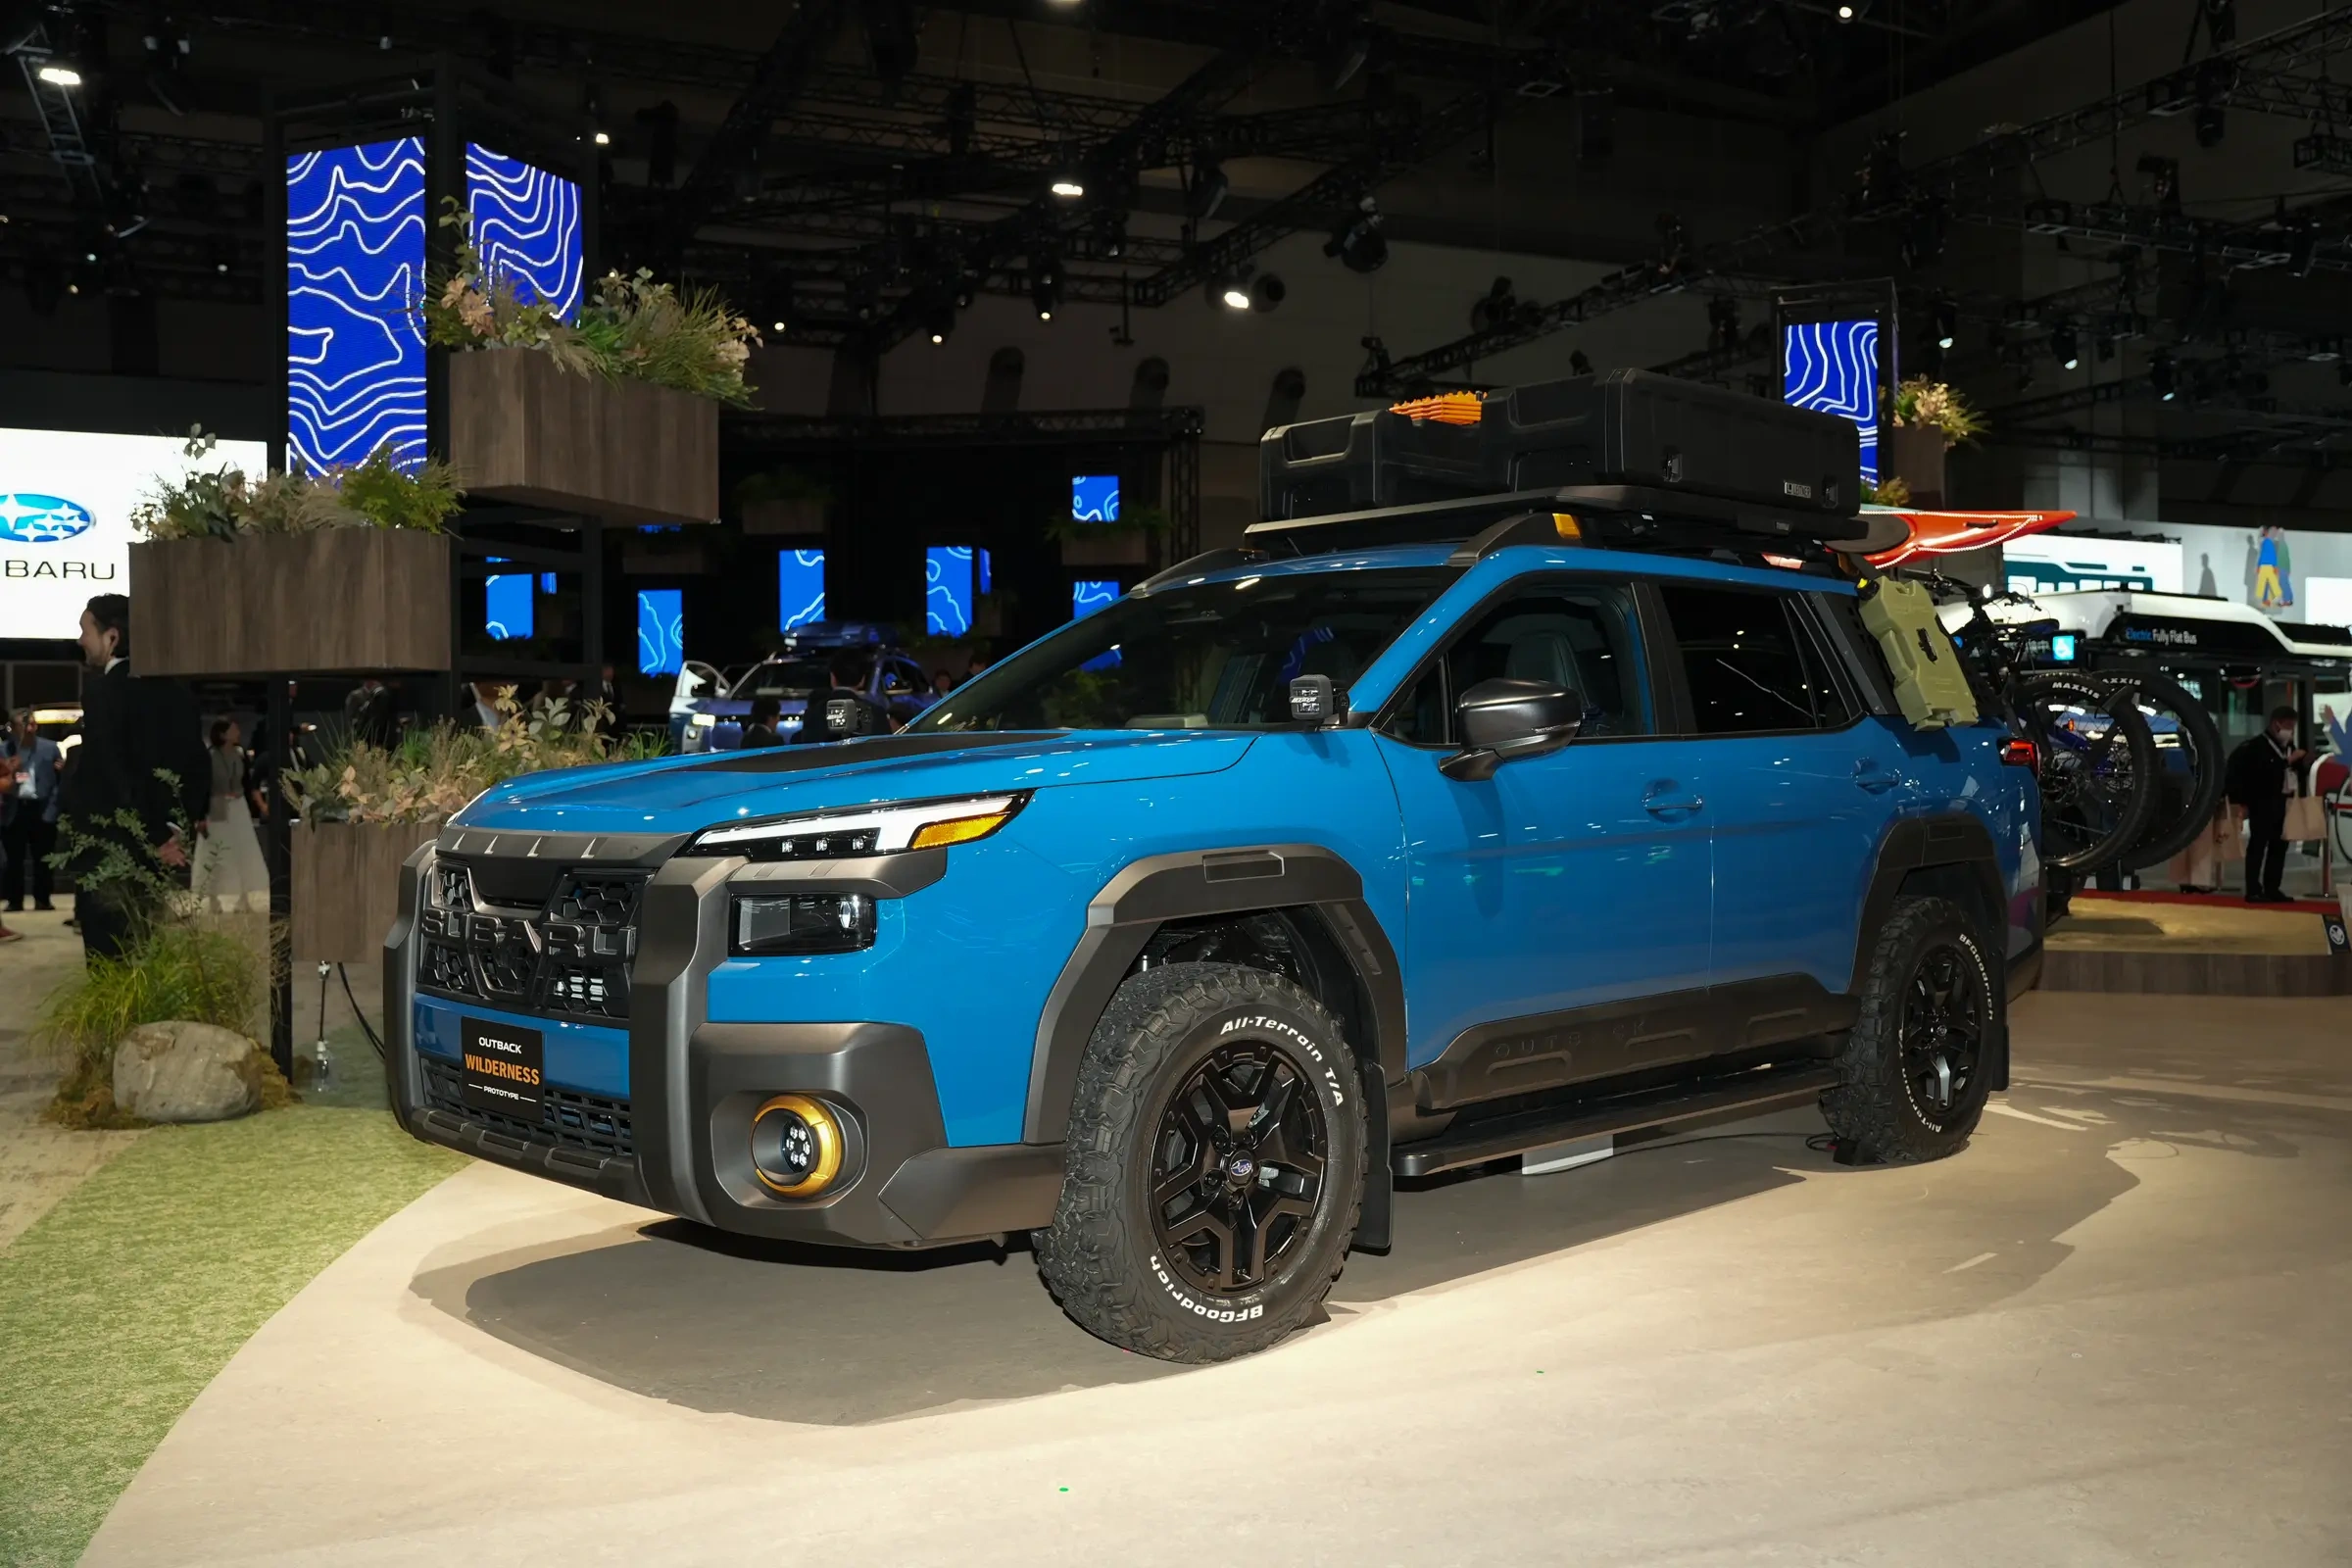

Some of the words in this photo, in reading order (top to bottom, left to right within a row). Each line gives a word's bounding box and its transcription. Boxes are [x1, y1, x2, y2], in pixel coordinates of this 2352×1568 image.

[2126, 627, 2152, 640] Electric
[2153, 629, 2169, 646] Fully
[2170, 630, 2183, 645] Flat
[2183, 631, 2197, 645] Bus
[2052, 681, 2100, 700] MAXXIS
[2102, 677, 2142, 686] AXXIS
[420, 908, 637, 962] SUBARU
[1959, 933, 1994, 1020] BFGoodrich
[478, 1036, 522, 1055] OUTBACK
[1494, 1018, 1646, 1058] OUTBCK
[465, 1054, 540, 1087] WILDERNESS
[1220, 1015, 1323, 1063] All-Terrain
[1324, 1067, 1345, 1106] T/A
[483, 1085, 519, 1102] PROTOTYPE
[1151, 1254, 1264, 1323] BFGoodrich
